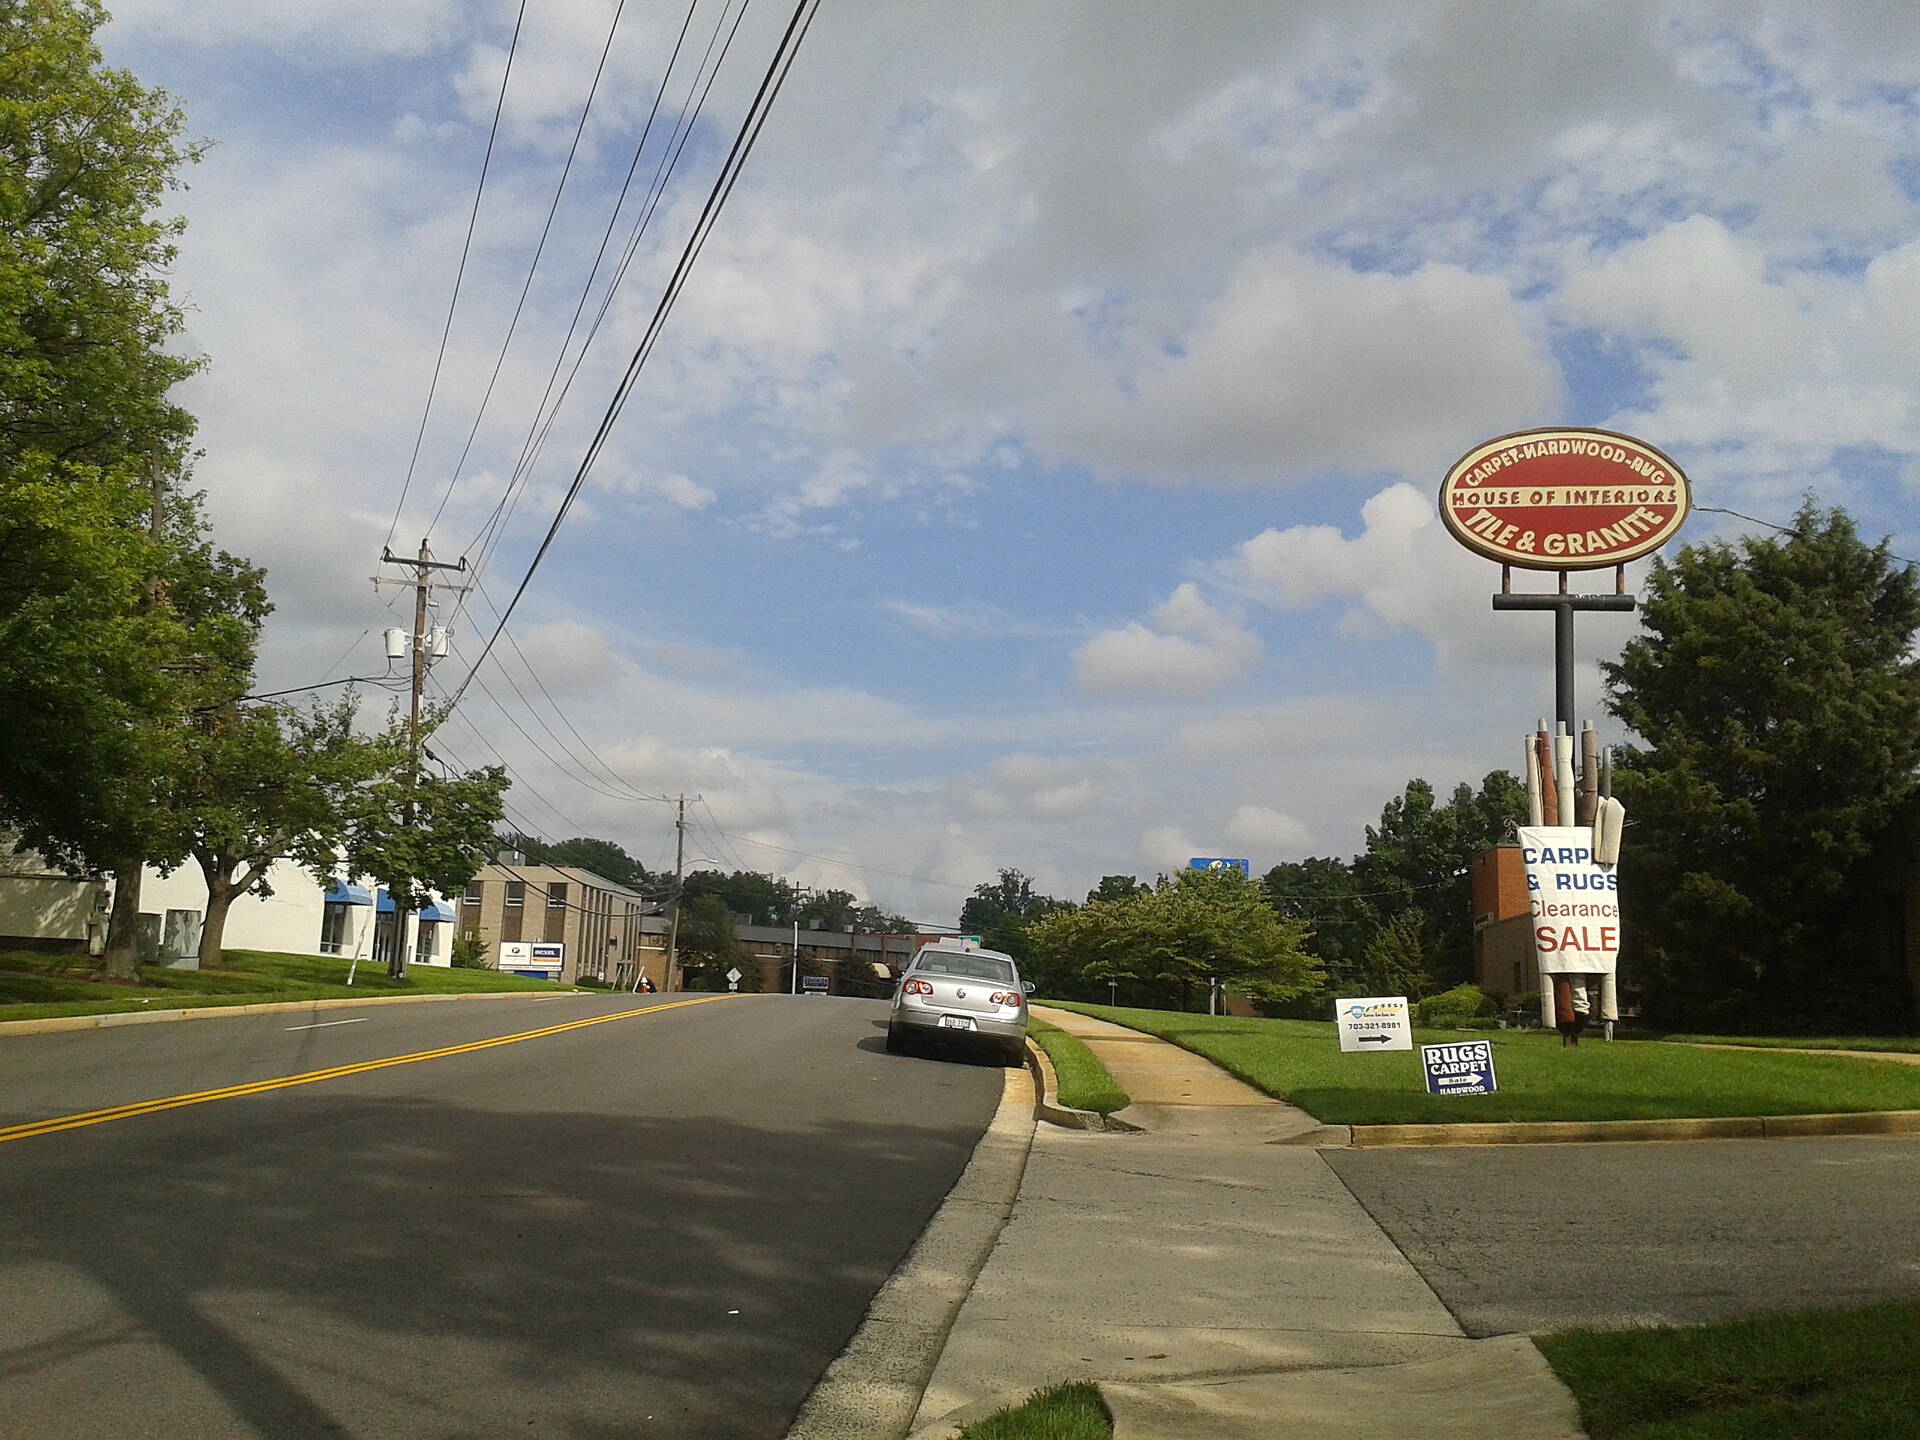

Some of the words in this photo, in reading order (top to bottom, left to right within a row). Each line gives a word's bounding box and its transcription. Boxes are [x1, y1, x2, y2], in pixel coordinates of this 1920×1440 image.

[1452, 490, 1520, 506] HOUSE
[1530, 490, 1555, 505] OF
[1565, 489, 1677, 505] INTERIORS
[1464, 508, 1520, 546] TILE
[1515, 530, 1536, 553] &
[1543, 506, 1665, 555] GRANITE
[1527, 873, 1540, 891] &
[1556, 873, 1618, 891] RUGS
[1530, 900, 1618, 918] Clearance
[1536, 926, 1618, 953] SALE
[1425, 1044, 1488, 1065] RUGS
[1430, 1060, 1487, 1076] CARPET
[1440, 1086, 1486, 1095] HARDWOOD
